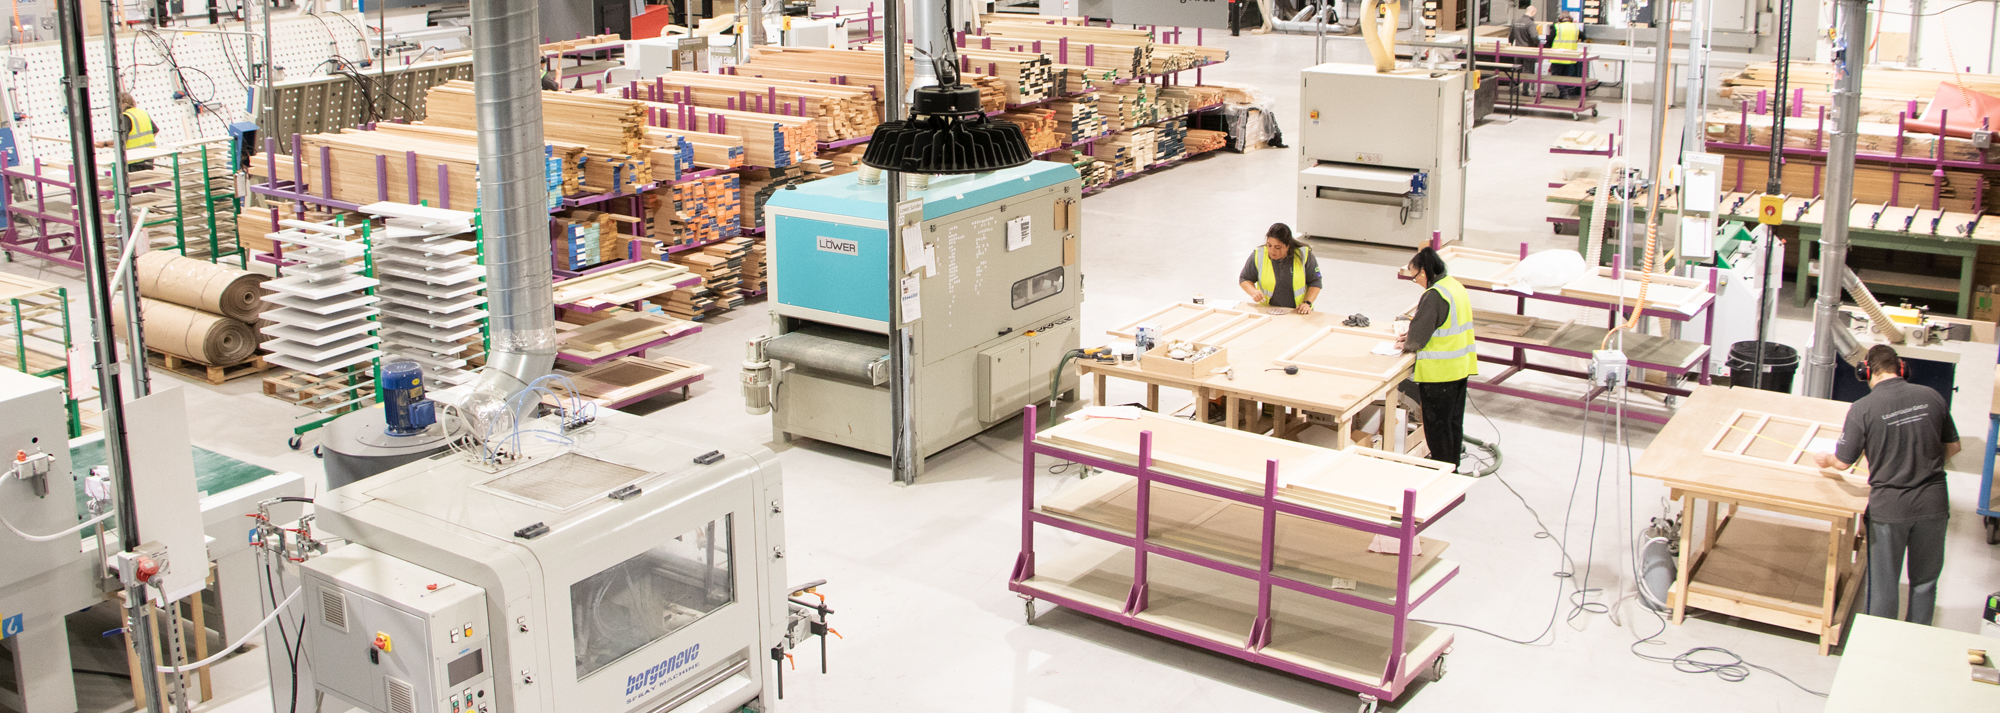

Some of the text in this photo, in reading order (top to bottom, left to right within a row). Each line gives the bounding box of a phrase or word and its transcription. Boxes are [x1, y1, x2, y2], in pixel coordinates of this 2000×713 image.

[819, 239, 856, 252] LÖWER
[626, 643, 700, 696] borgonovo
[626, 661, 700, 704] SPRAY MACHINE
